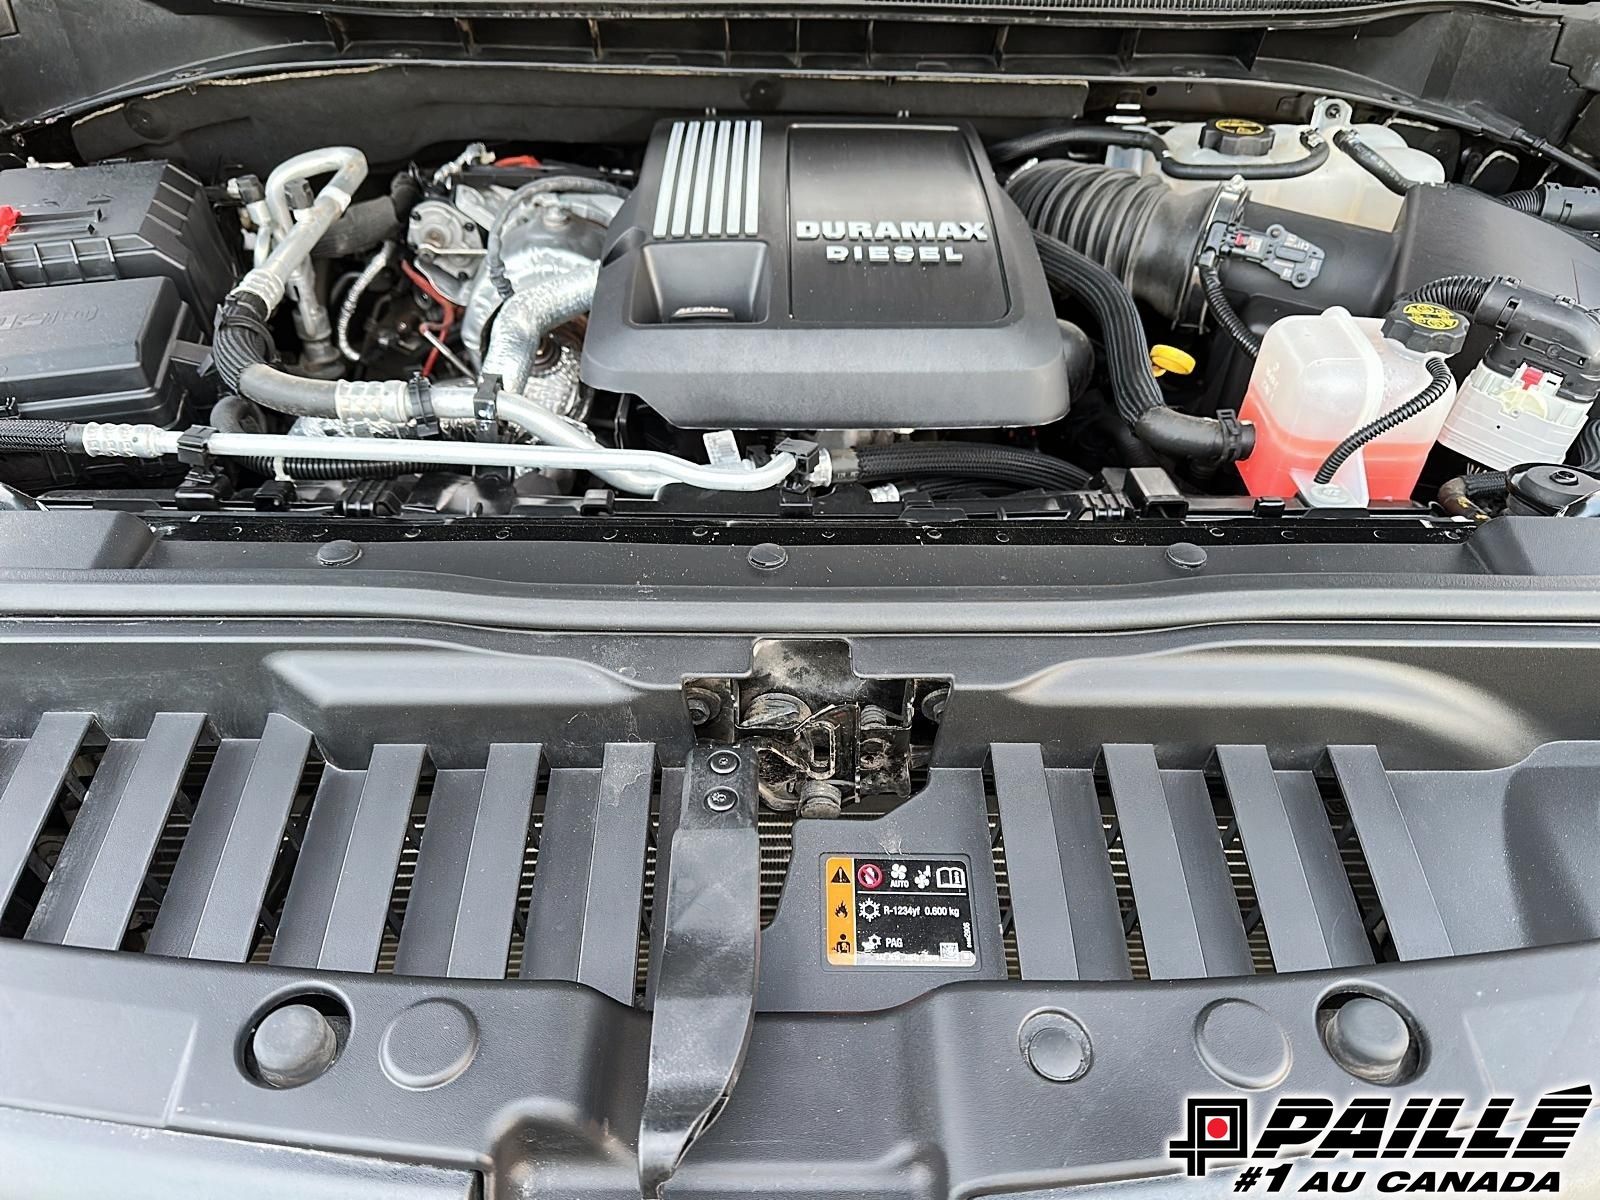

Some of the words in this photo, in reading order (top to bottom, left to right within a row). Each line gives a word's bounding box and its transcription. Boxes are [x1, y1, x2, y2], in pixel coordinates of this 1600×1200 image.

[796, 220, 988, 241] DURAMAX
[826, 245, 964, 262] DIESEL
[890, 879, 910, 888] AUTO
[883, 905, 920, 917] R-1234yf
[924, 906, 948, 916] 0.600
[949, 906, 960, 918] kg
[885, 937, 903, 948] PAG
